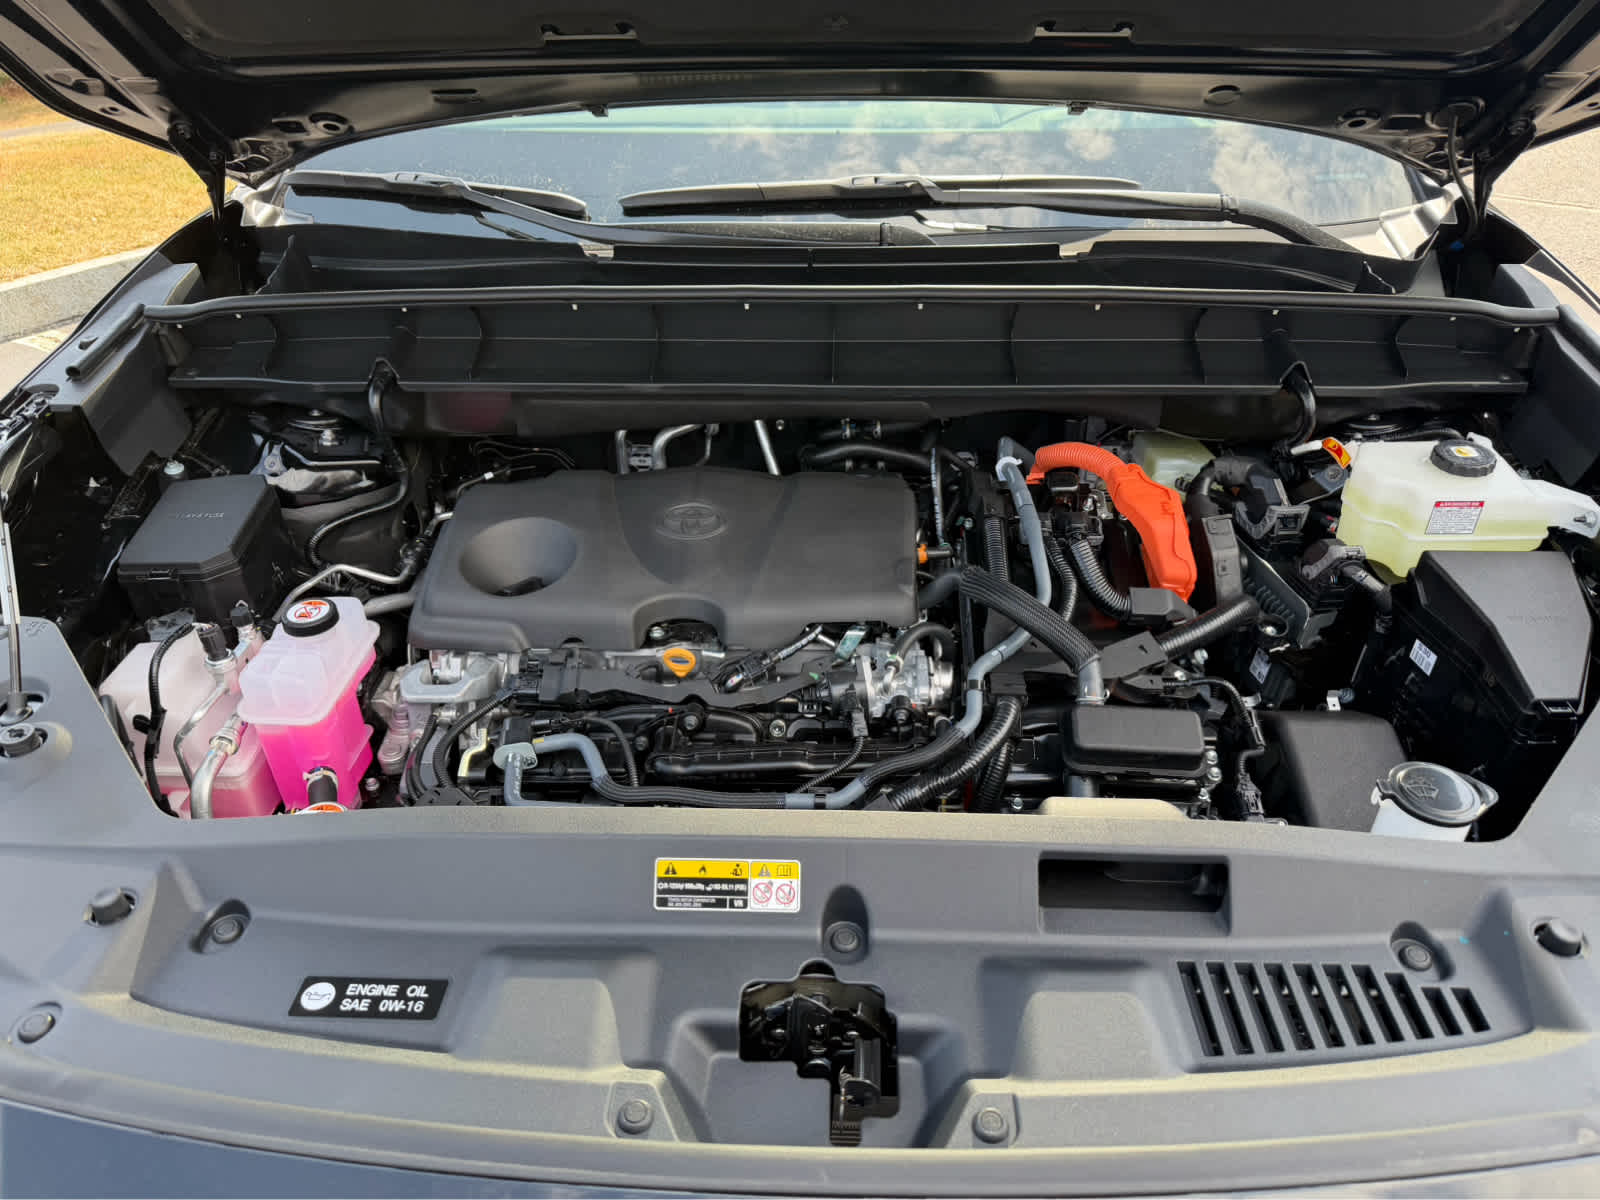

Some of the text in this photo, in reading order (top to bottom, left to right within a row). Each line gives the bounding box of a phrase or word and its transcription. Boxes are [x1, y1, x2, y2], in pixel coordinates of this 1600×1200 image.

[346, 983, 429, 998] ENGINE OIL
[339, 999, 425, 1012] SAE 0W-16
